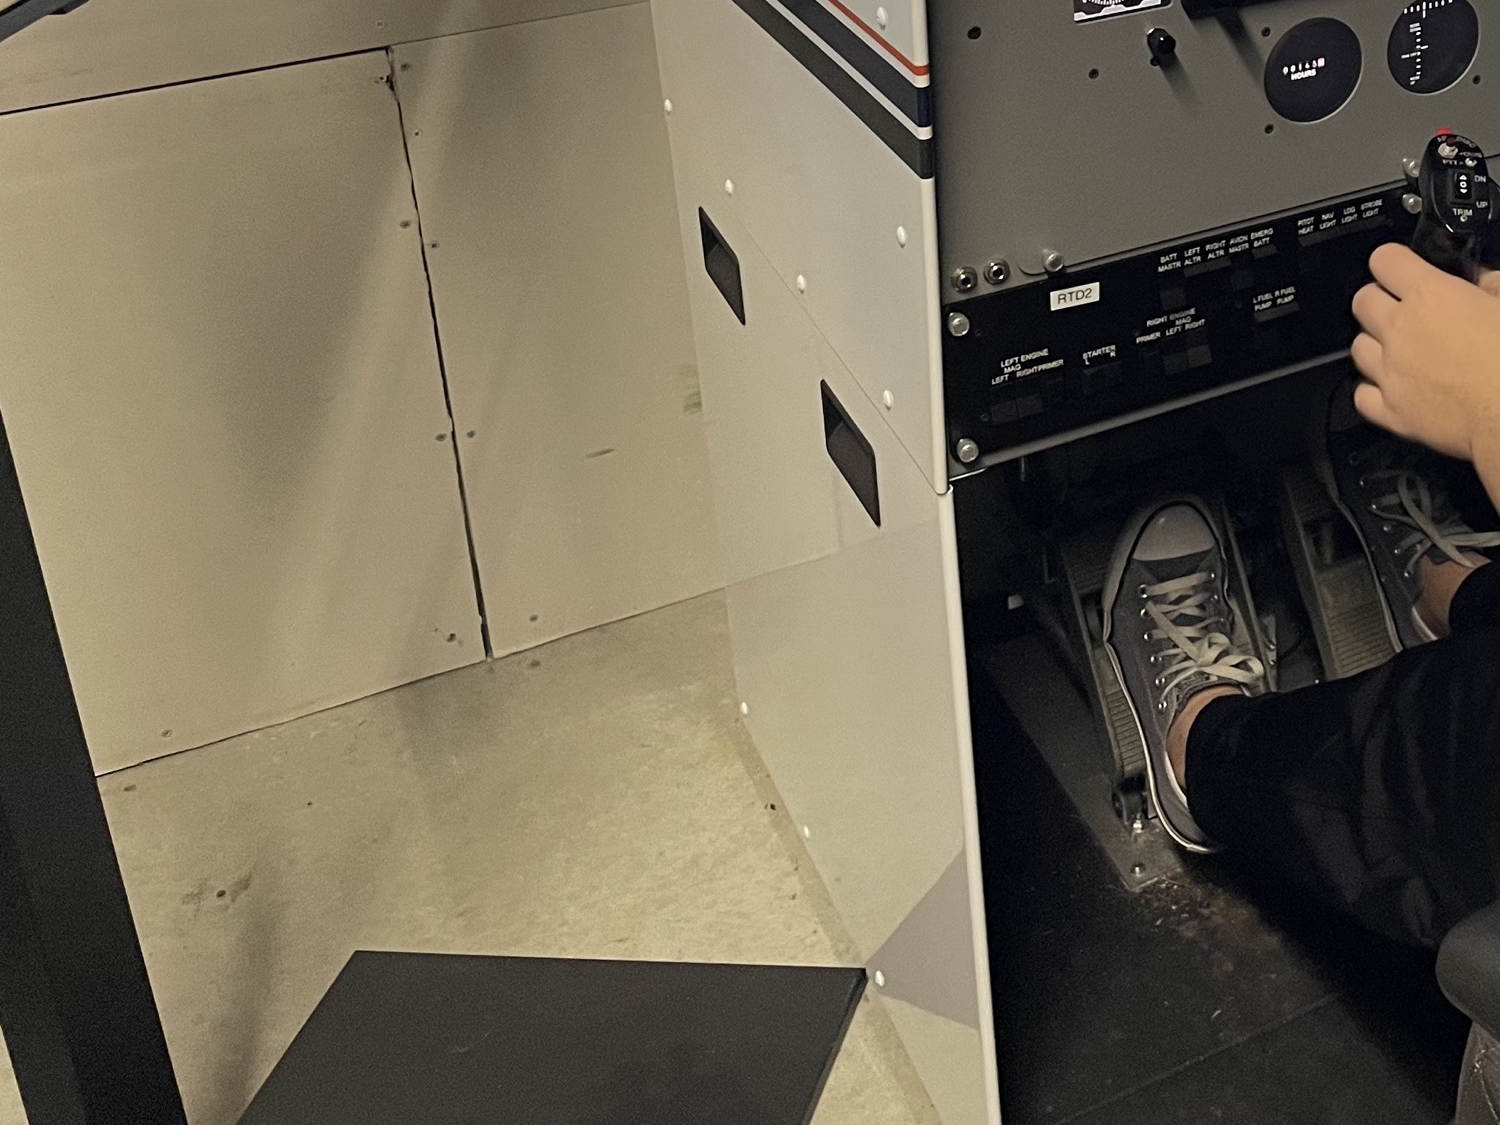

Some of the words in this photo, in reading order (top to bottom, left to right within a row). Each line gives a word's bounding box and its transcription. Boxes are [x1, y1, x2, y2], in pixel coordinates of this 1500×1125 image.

[1291, 68, 1317, 81] HOURS
[1474, 175, 1486, 183] DN
[1321, 212, 1334, 221] NAV
[1362, 208, 1380, 218] LIGHT
[1452, 208, 1472, 216] TRIM
[1319, 219, 1337, 230] LIGHT
[1341, 214, 1358, 225] LIGHT
[1250, 228, 1274, 240] EMERG
[1298, 225, 1314, 235] HEAT
[1205, 240, 1226, 251] RIGHT
[1229, 235, 1248, 245] AVION
[1253, 237, 1270, 248] BATT
[1184, 246, 1201, 257] LEFT
[1229, 243, 1249, 254] MASTR
[1160, 252, 1178, 263] BATT
[1207, 249, 1225, 260] ALTR
[1184, 255, 1202, 266] ALTR
[1158, 261, 1181, 273] MASTR
[1057, 288, 1092, 304] RTD2
[1280, 286, 1296, 296] FUEL
[1257, 293, 1273, 302] FUEL
[1276, 295, 1294, 305] PUMP
[1254, 301, 1272, 312] PUMP
[1146, 315, 1168, 327] RIGHT
[1169, 307, 1196, 320] ENGINE
[1175, 316, 1192, 326] MAG
[1166, 325, 1182, 336] LEFT
[1185, 318, 1205, 330] RIGHT
[1136, 331, 1161, 344] PRIMER
[1082, 344, 1116, 360] STARTER
[1000, 355, 1020, 368] LEFT
[1020, 348, 1049, 362] ENGINE
[991, 374, 1009, 385] LEFT
[1016, 366, 1038, 378] RIGHT
[1038, 358, 1064, 371] PRIMER
[1003, 364, 1021, 374] MAG
